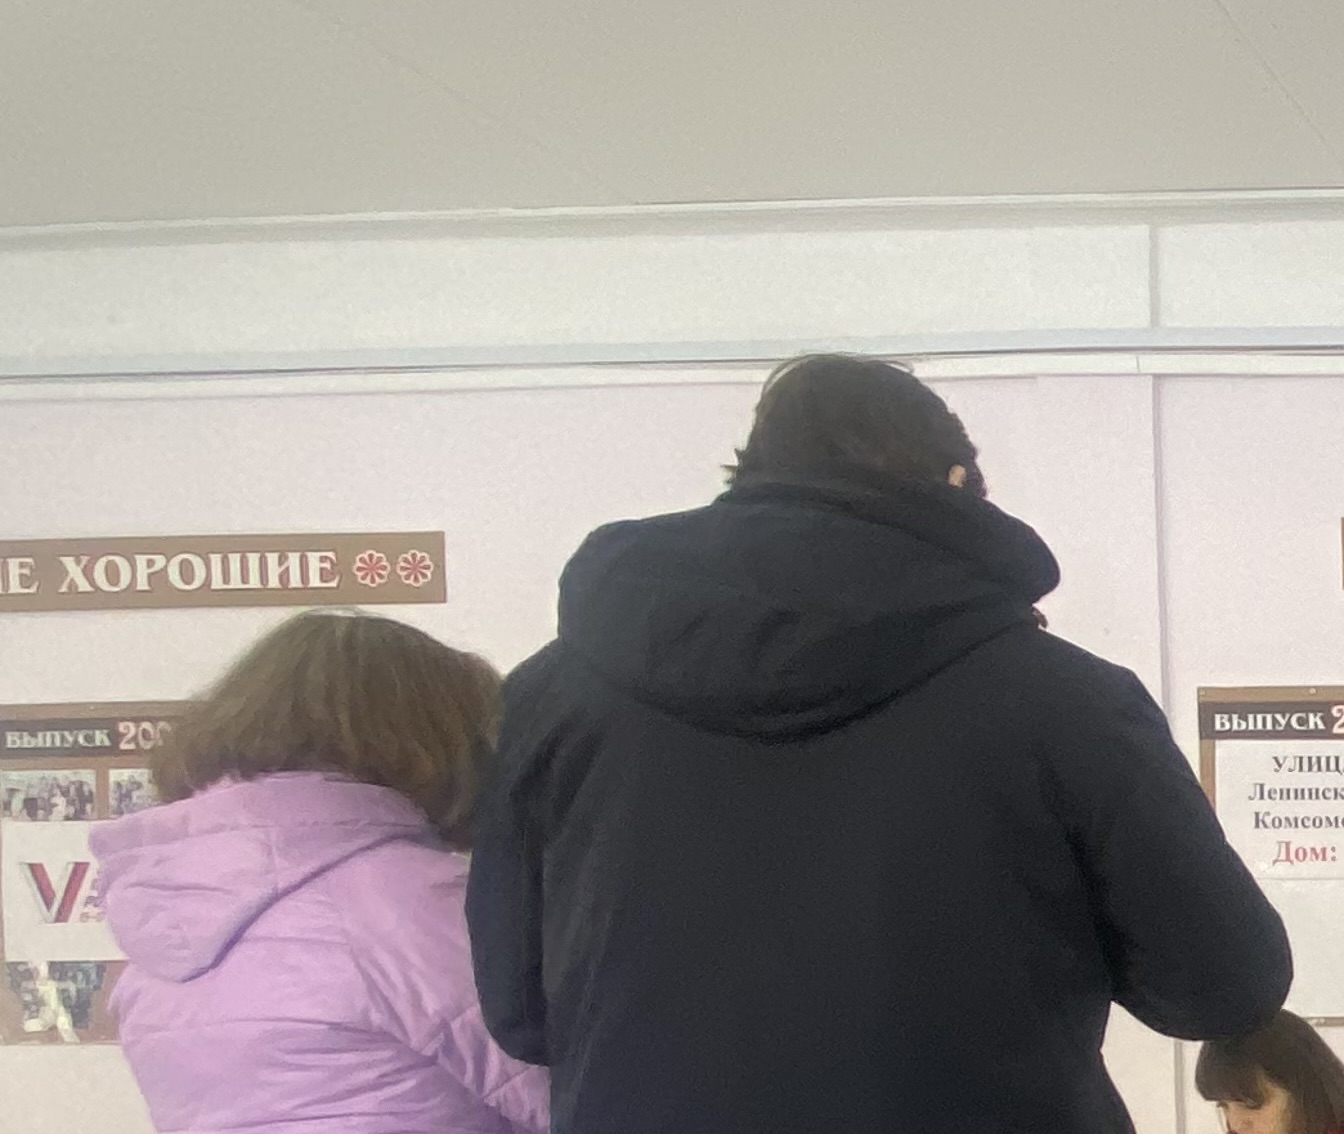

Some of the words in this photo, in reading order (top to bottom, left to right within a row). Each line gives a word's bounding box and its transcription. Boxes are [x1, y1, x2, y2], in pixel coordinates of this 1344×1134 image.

[0, 556, 39, 595] Е
[58, 551, 341, 593] ХОРОШИЕ
[1213, 712, 1326, 732] ВЫПУСК
[5, 729, 112, 749] ВЫПУСК
[1272, 841, 1337, 865] Дом:
